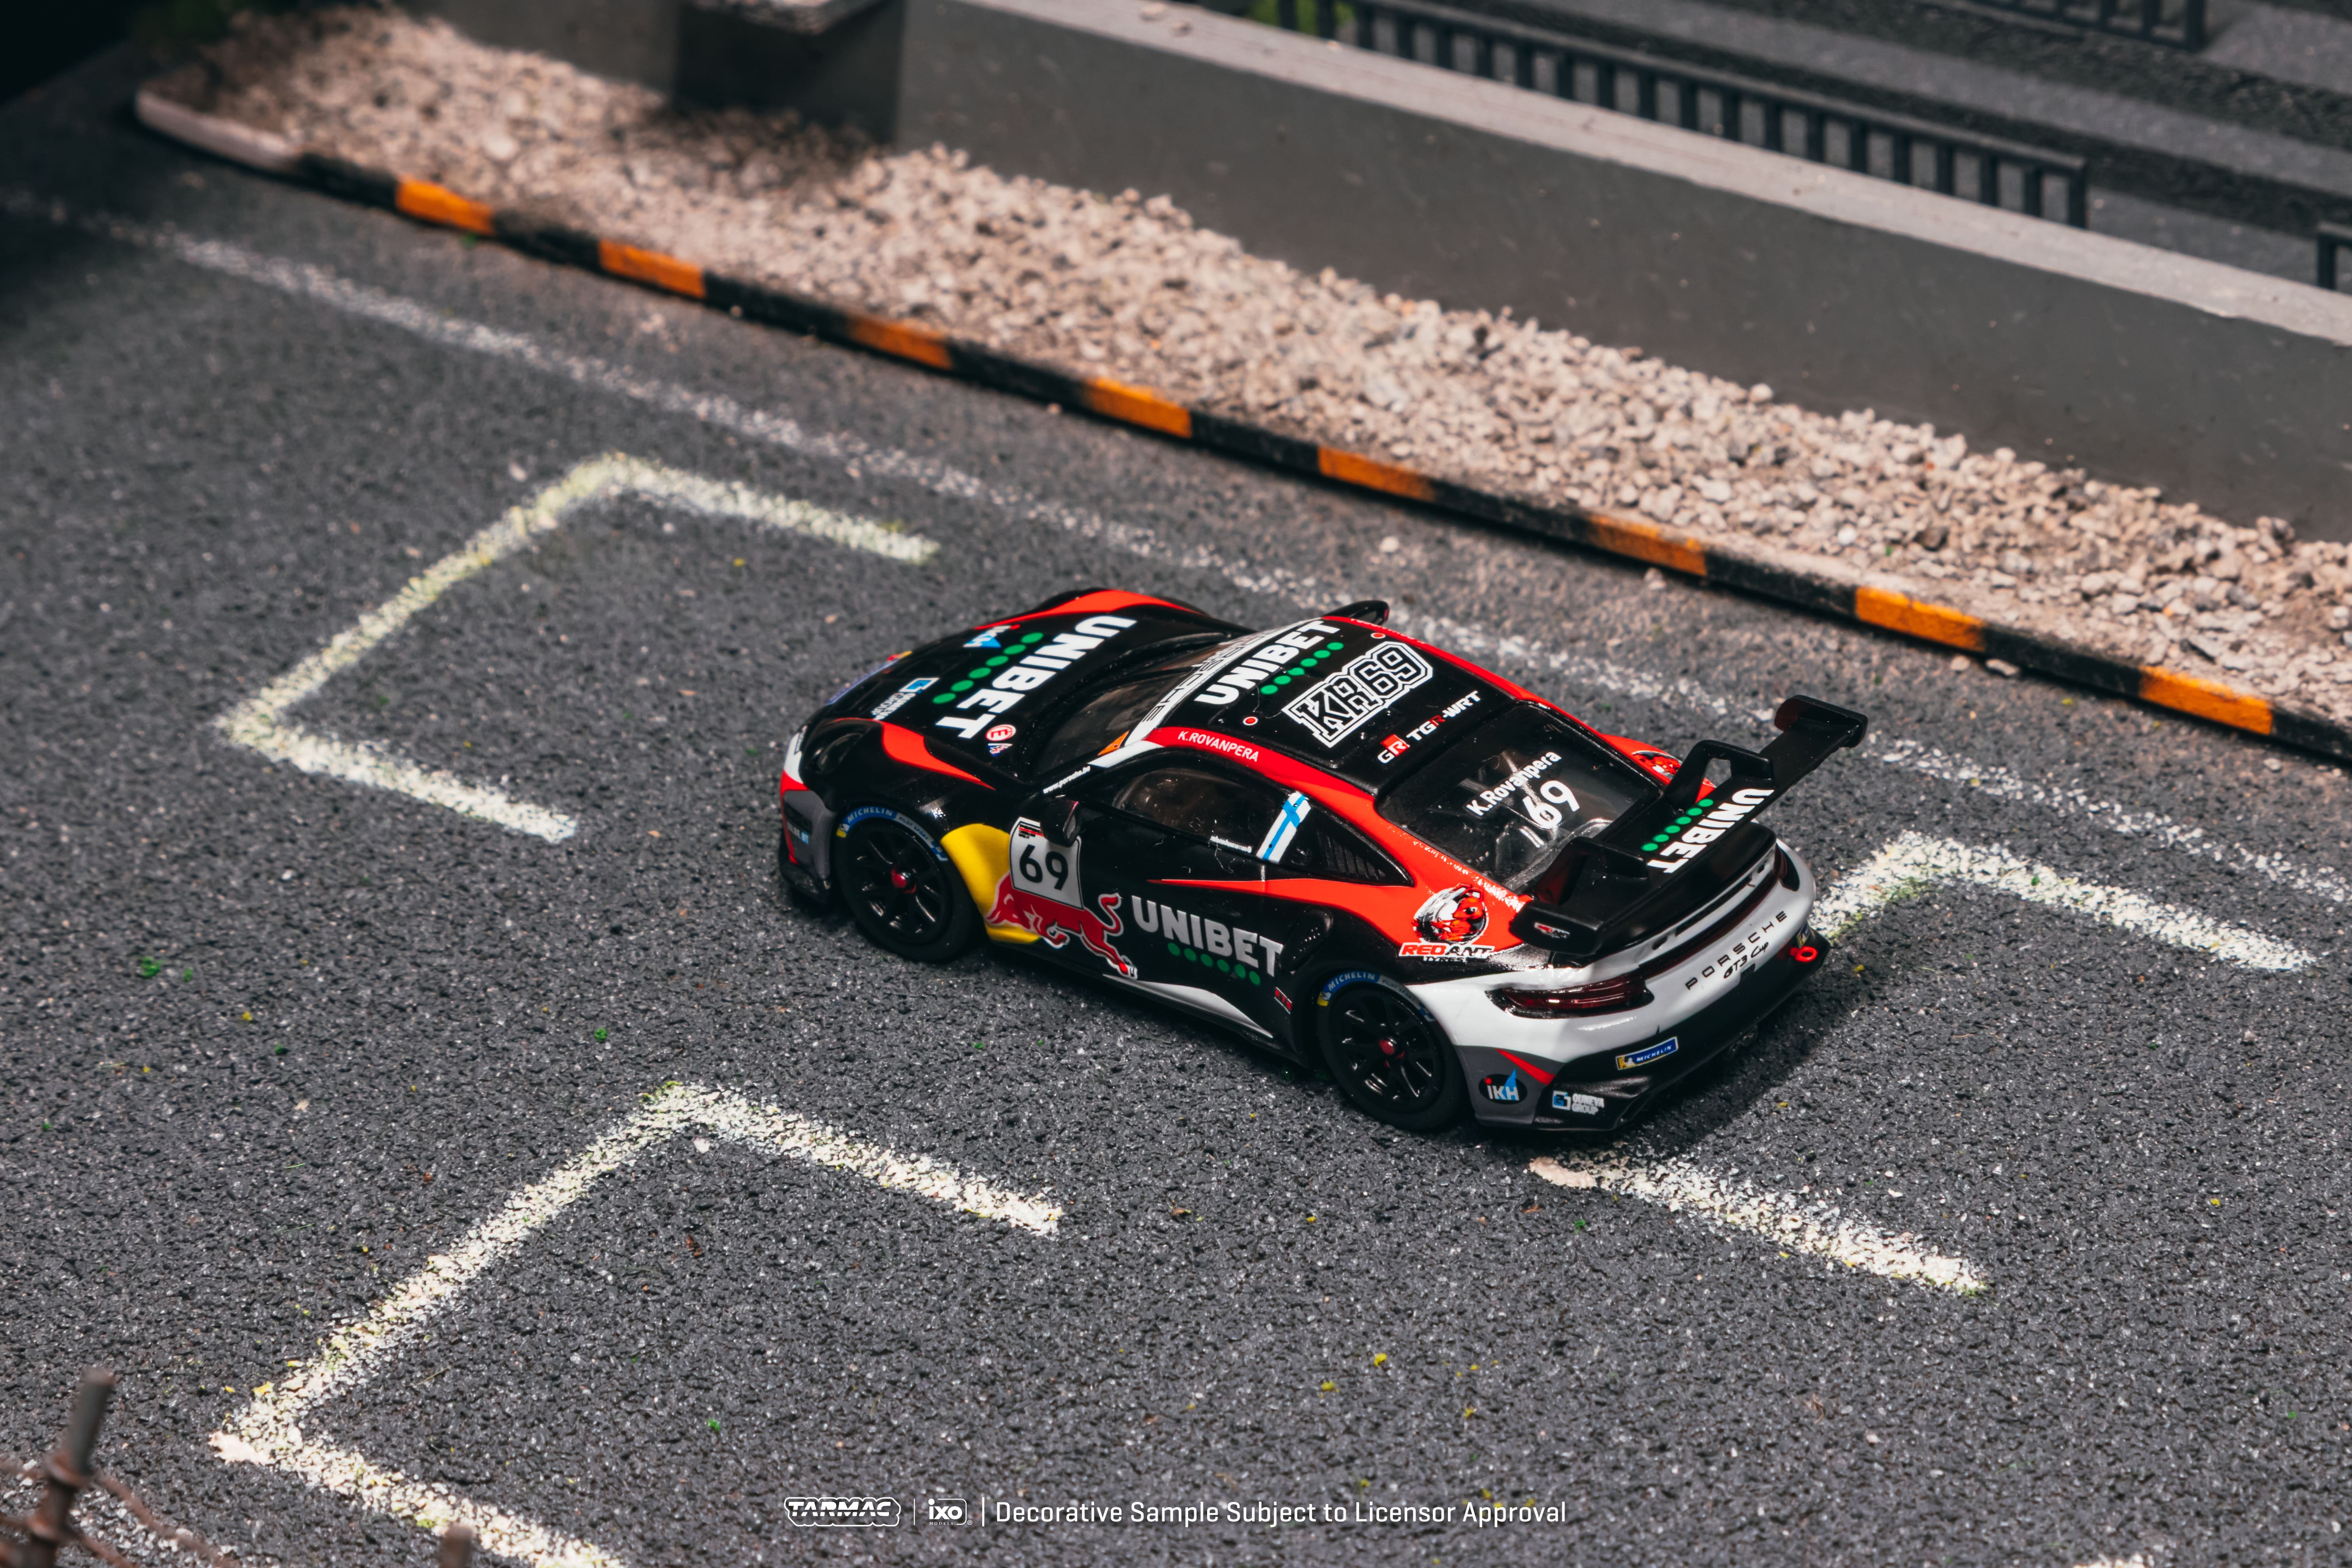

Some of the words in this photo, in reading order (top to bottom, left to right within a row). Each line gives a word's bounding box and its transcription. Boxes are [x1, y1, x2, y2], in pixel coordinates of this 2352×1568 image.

[935, 616, 1137, 739] UNIBET
[1143, 628, 1279, 722] ORSCHE
[1193, 620, 1341, 705] UNIBET
[1281, 641, 1433, 748] KR69
[1177, 731, 1259, 762] K.ROVANPERA
[1377, 738, 1408, 764] GR
[1406, 691, 1481, 741] TGR-WRT
[847, 807, 893, 823] MICHELIN
[1466, 751, 1562, 816] K.Rovanpera
[1522, 780, 1580, 830] 69
[1646, 788, 1775, 874] UNIBET
[1019, 844, 1069, 891] 69
[1131, 895, 1284, 978] UNIBET
[1685, 910, 1787, 990] PORSCHE
[1723, 955, 1747, 979] GT3
[1751, 942, 1769, 958] Cup
[1328, 971, 1375, 991] MICHELIN
[1636, 1045, 1672, 1062] MICHELIN
